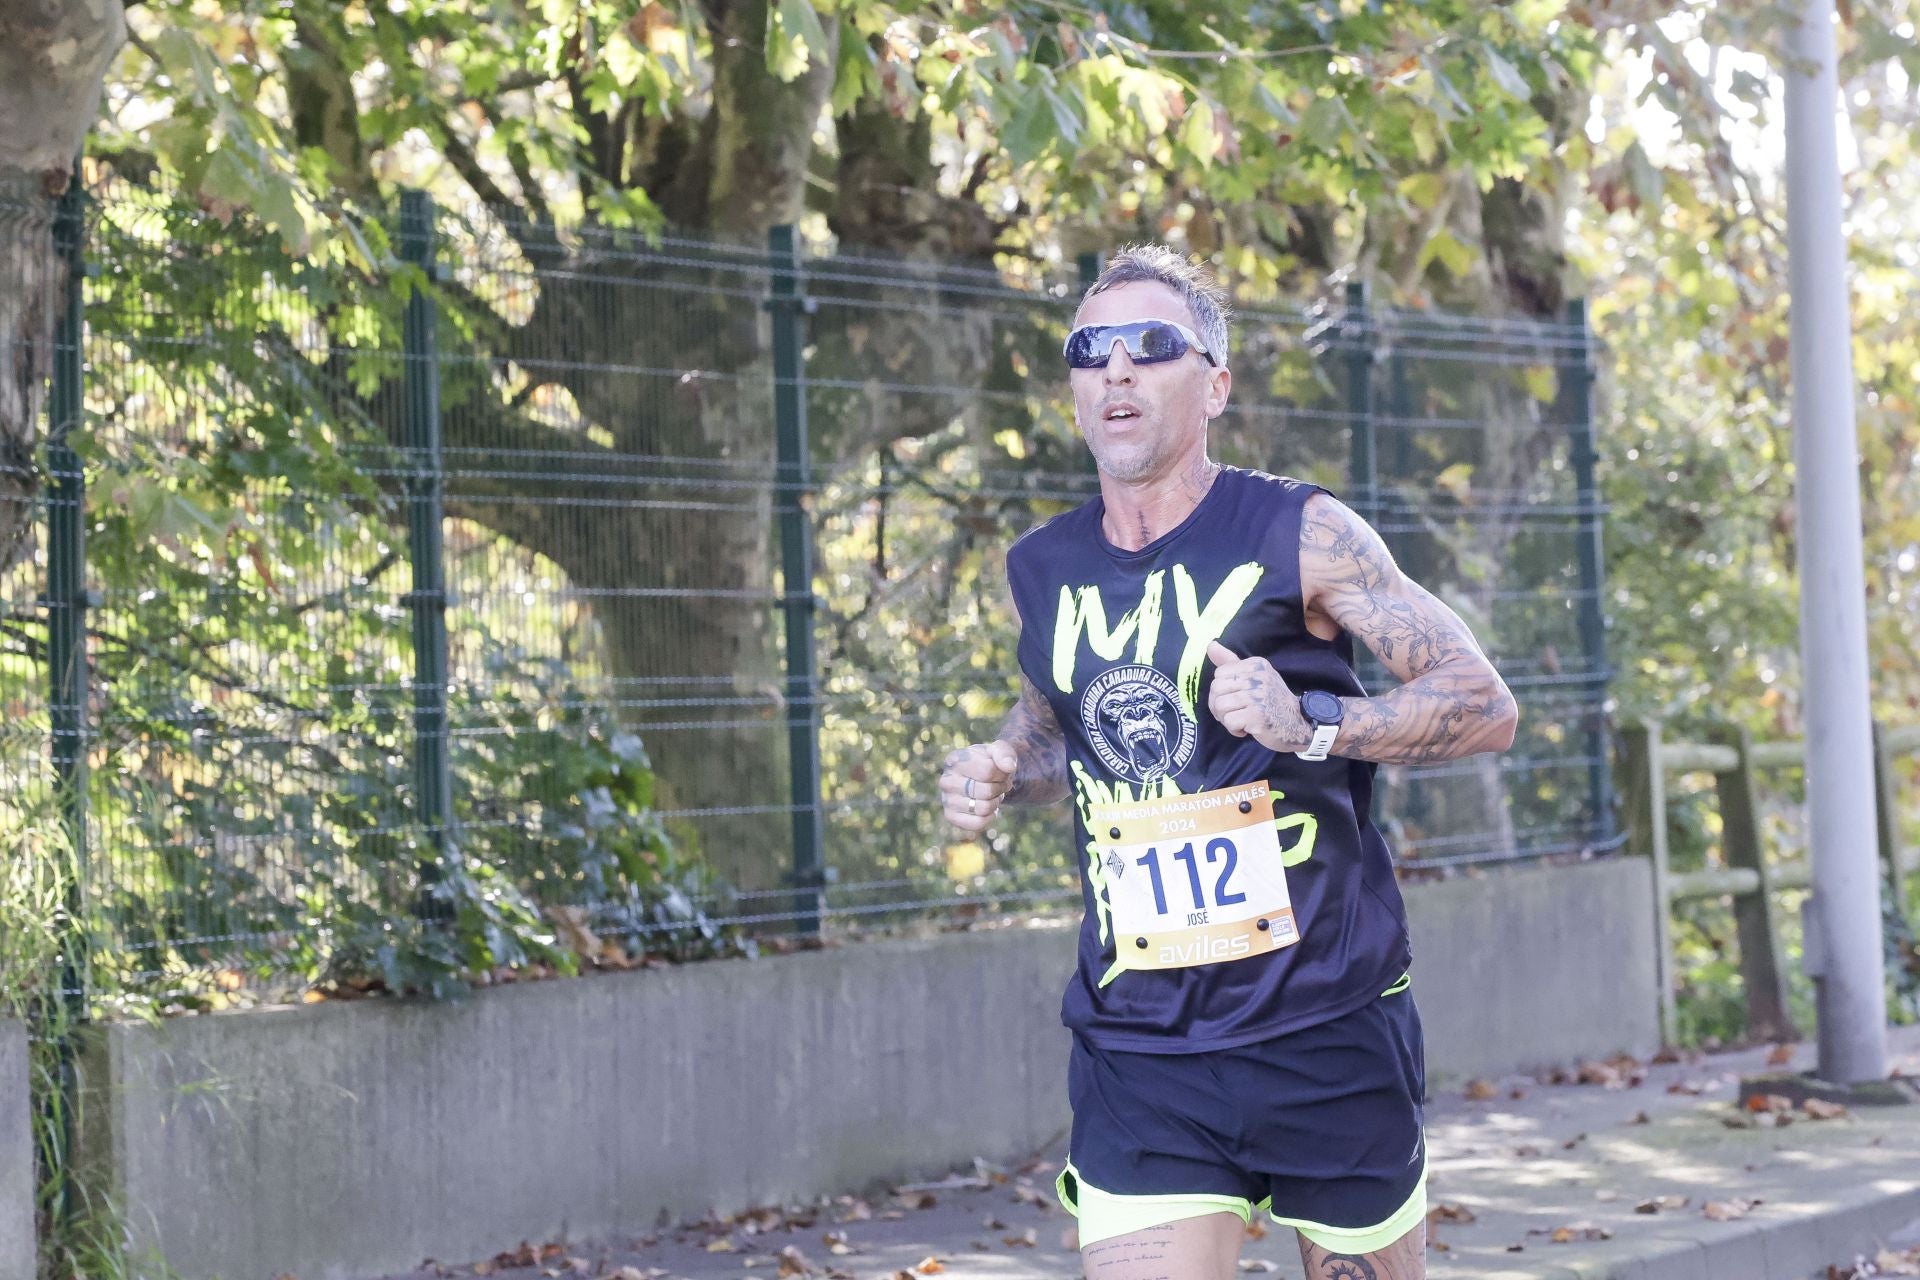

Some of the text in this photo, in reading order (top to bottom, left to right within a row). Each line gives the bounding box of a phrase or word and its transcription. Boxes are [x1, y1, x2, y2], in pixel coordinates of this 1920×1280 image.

[1053, 561, 1264, 723] MY
[1102, 668, 1152, 690] CARADURA
[1083, 680, 1106, 730] CARADURA
[1090, 731, 1130, 774] CARADURA
[1123, 807, 1160, 820] MEDIA
[1162, 797, 1222, 815] MARATÓN
[1224, 786, 1266, 805] AVILÉS
[1160, 819, 1197, 834] 2024
[1136, 838, 1246, 915] 112
[1187, 911, 1209, 926] JOSÉ
[1159, 934, 1250, 964] avilés
